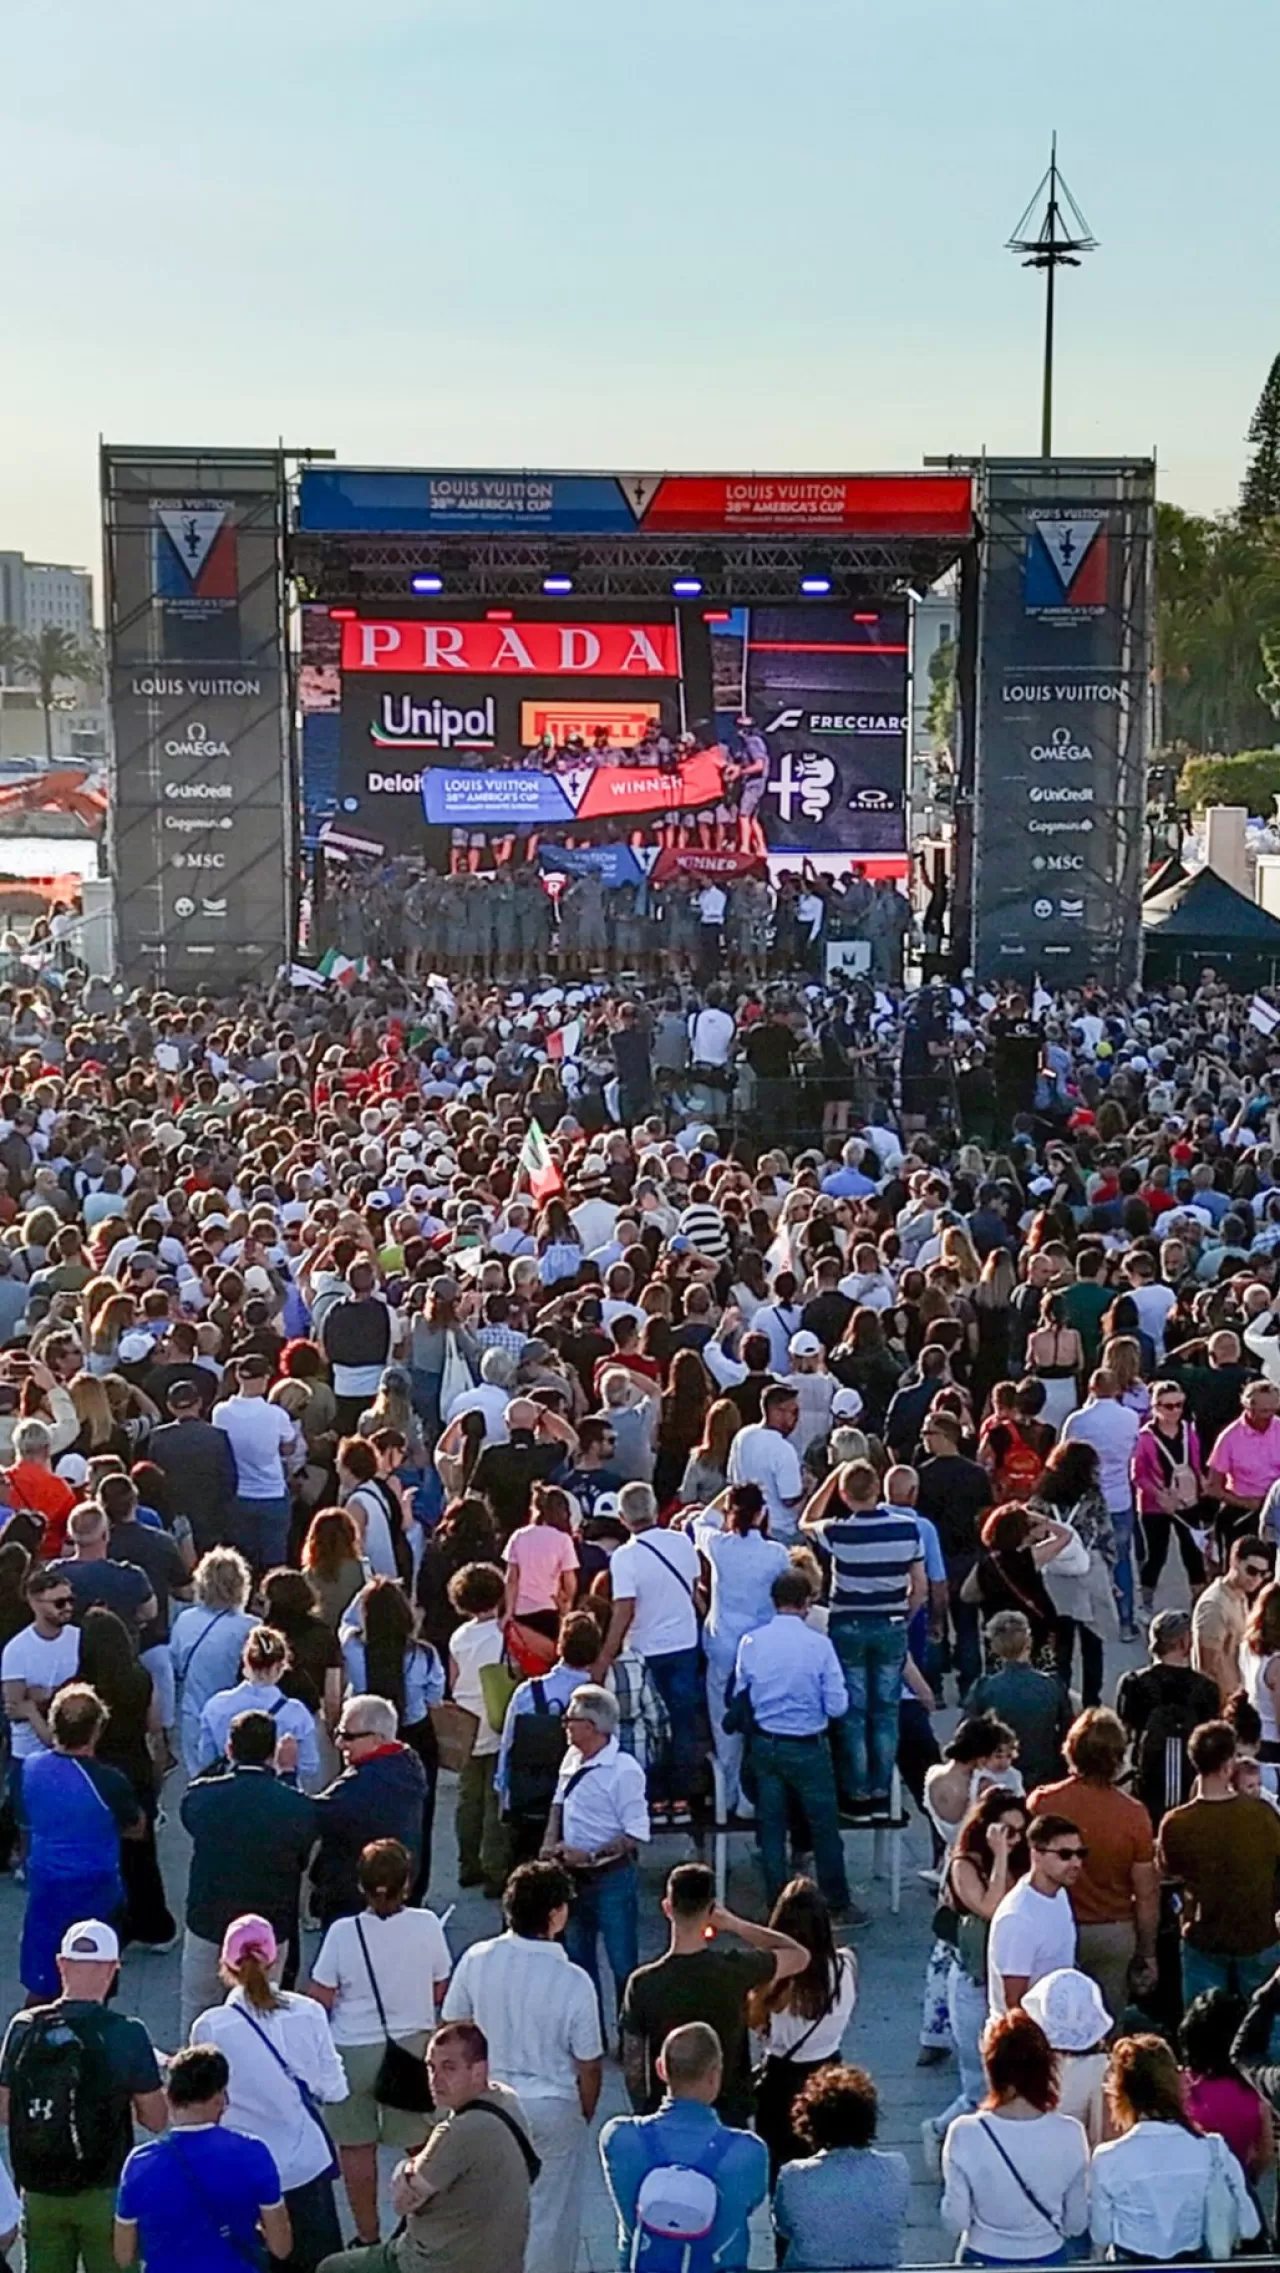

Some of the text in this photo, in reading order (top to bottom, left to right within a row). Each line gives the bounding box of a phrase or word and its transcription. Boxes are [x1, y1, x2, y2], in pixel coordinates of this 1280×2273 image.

[429, 481, 553, 498] LOUIS VUITTON
[725, 484, 847, 499] LOUIS VUITTON
[526, 500, 553, 512] CUP
[752, 501, 817, 513] AMERICA'S
[819, 500, 845, 513] CUP
[360, 625, 665, 671] PRADA
[132, 680, 261, 695] LOUIS VUITTON
[1003, 686, 1124, 701] LOUIS VUITTON
[383, 695, 496, 747] Unipol
[165, 741, 231, 757] OMEGA
[1030, 746, 1093, 761] OMEGA
[368, 773, 422, 792] Deloi
[444, 779, 539, 791] LOUIS VUITTON
[186, 853, 225, 869] MSC
[1047, 855, 1084, 870] MSC
